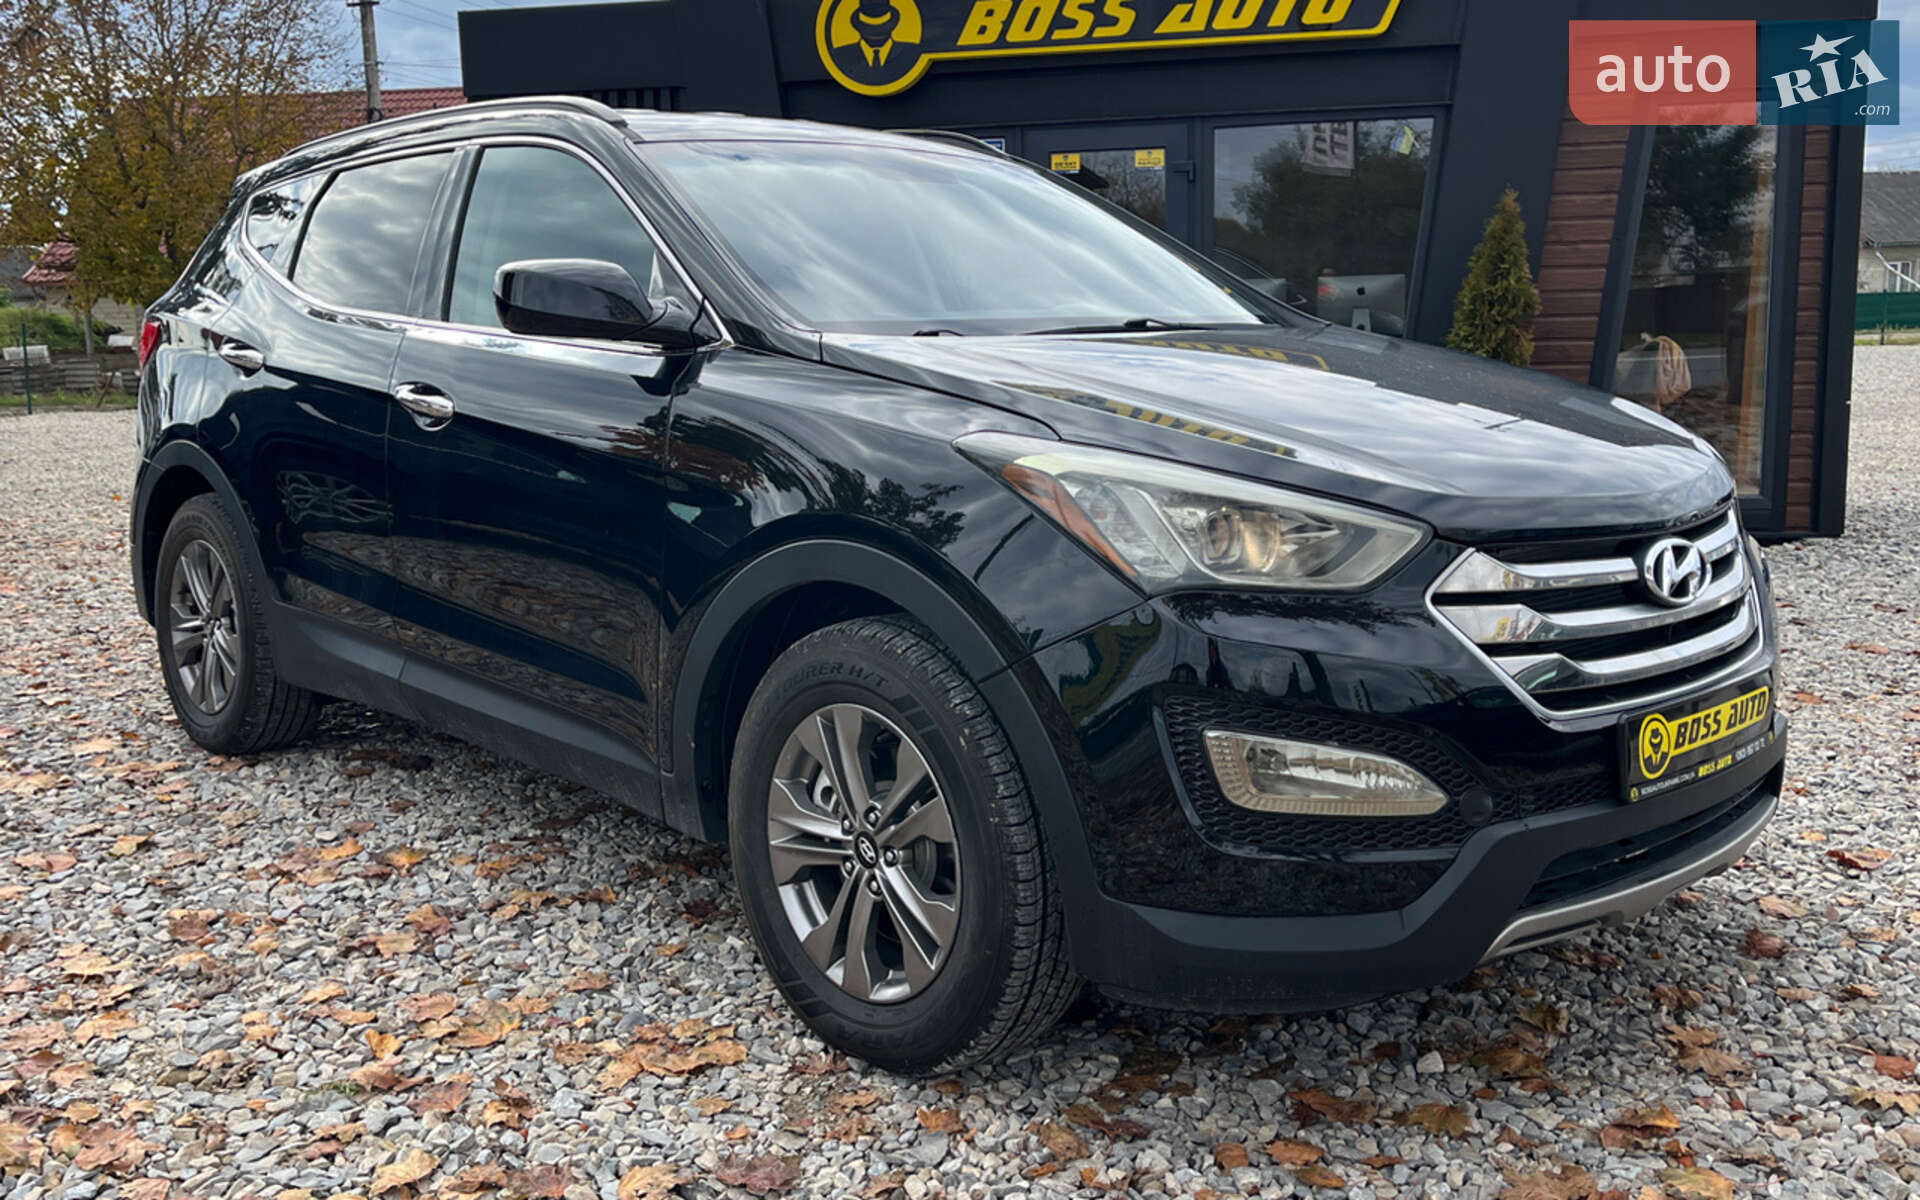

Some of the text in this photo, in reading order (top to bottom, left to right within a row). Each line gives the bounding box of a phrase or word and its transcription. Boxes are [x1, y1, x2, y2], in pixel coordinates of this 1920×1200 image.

[957, 0, 1136, 45] BOSS
[1675, 691, 1767, 749] BOSS AUTO
